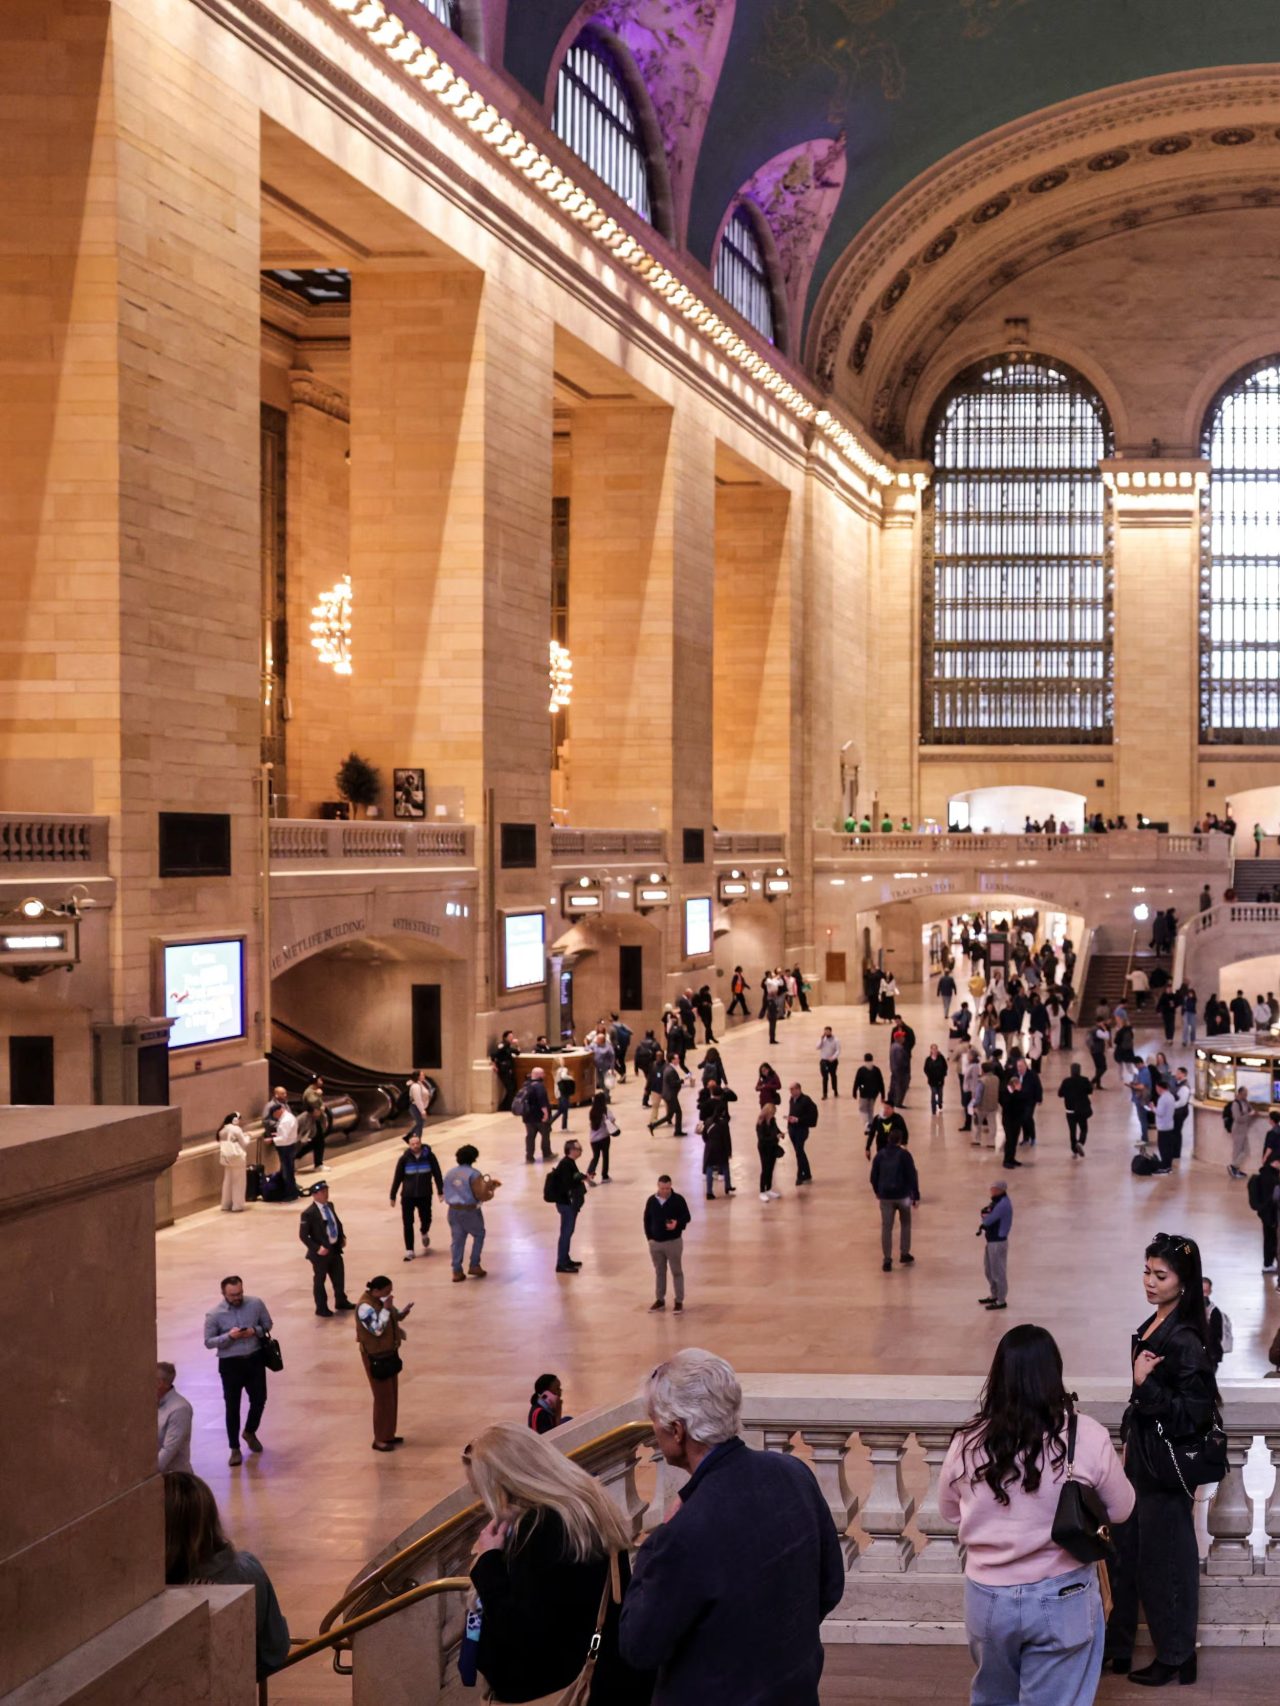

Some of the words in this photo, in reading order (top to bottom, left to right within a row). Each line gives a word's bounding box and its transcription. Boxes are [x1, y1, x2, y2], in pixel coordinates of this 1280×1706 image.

[282, 932, 322, 962] METLIFE
[322, 920, 365, 942] BUILDING
[412, 920, 440, 937] STREET
